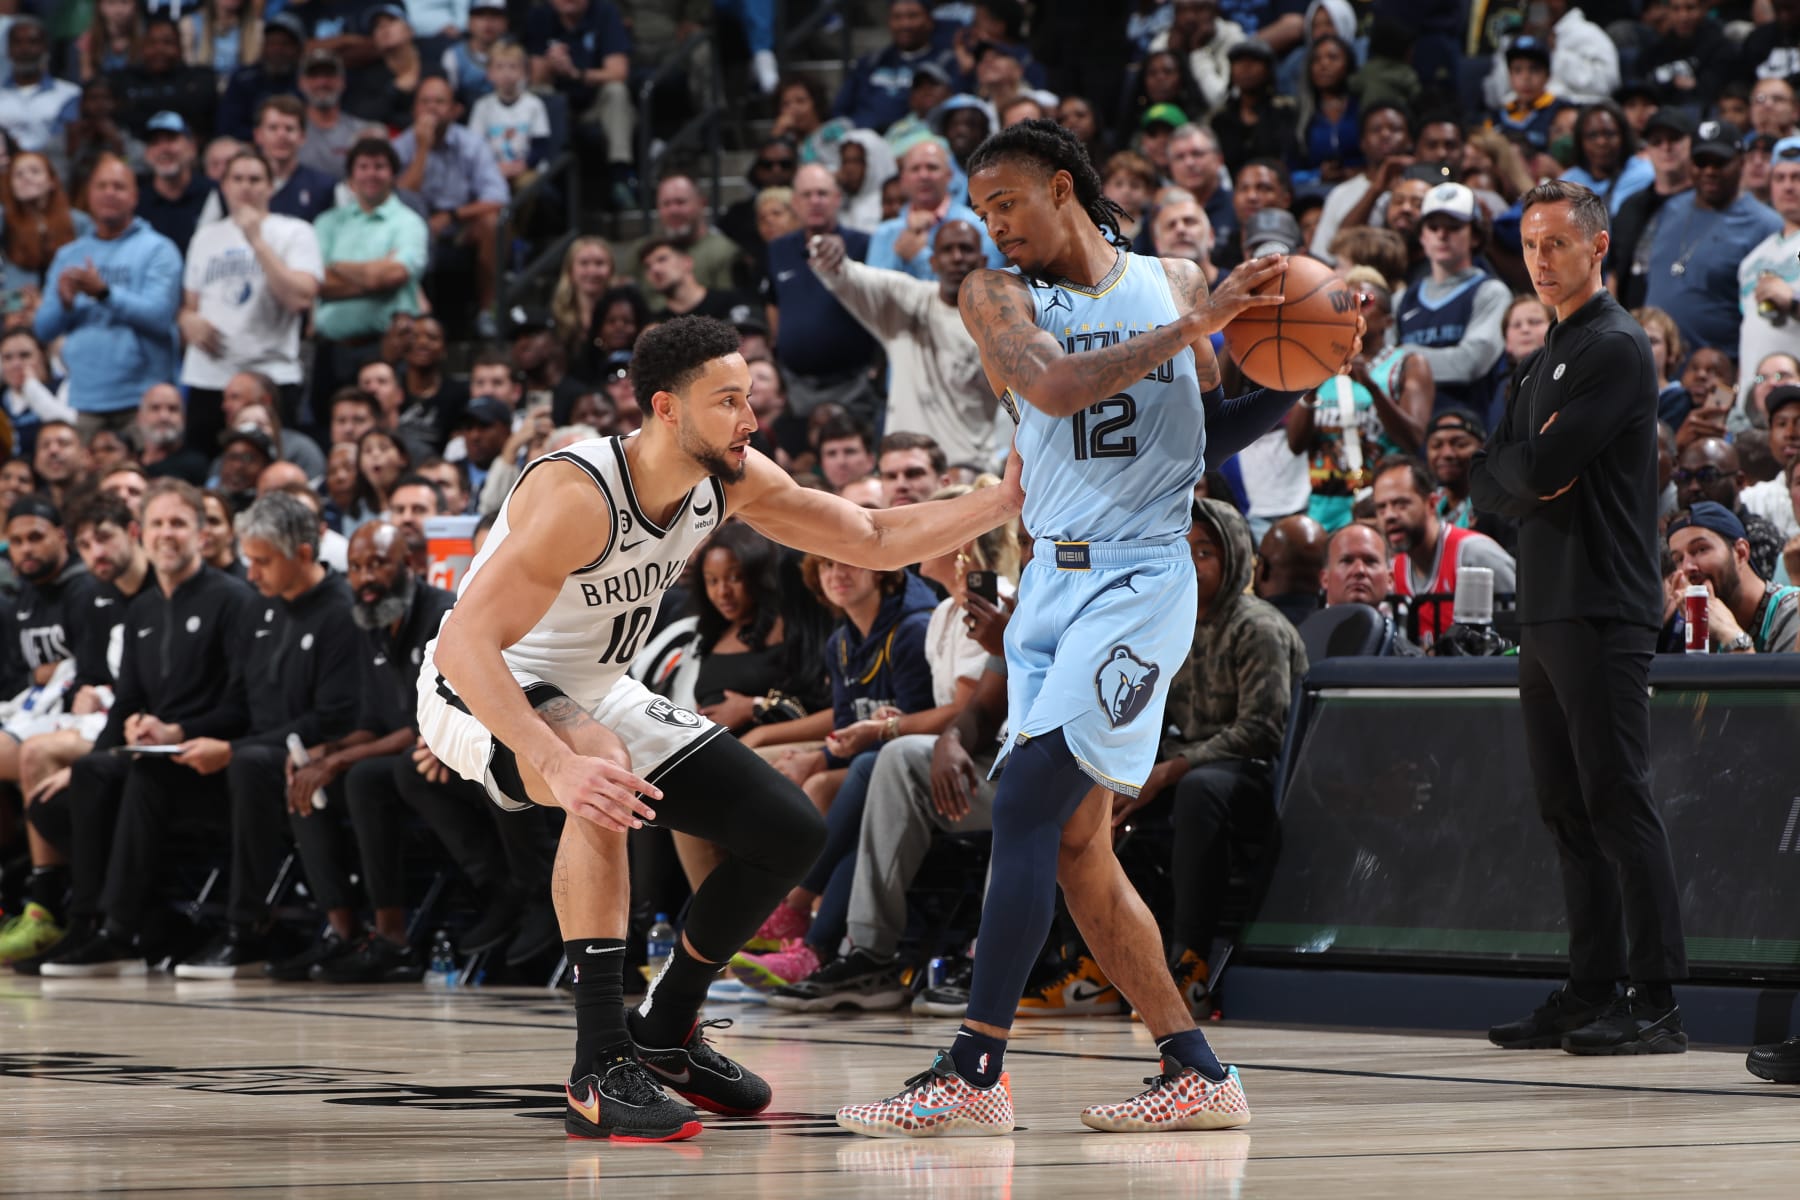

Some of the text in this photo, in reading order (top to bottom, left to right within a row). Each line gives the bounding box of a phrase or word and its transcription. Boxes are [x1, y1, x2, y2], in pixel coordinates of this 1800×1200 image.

[1060, 321, 1154, 337] EMPHIS
[1072, 392, 1137, 461] 12
[694, 518, 715, 530] Webull
[598, 606, 652, 664] 10
